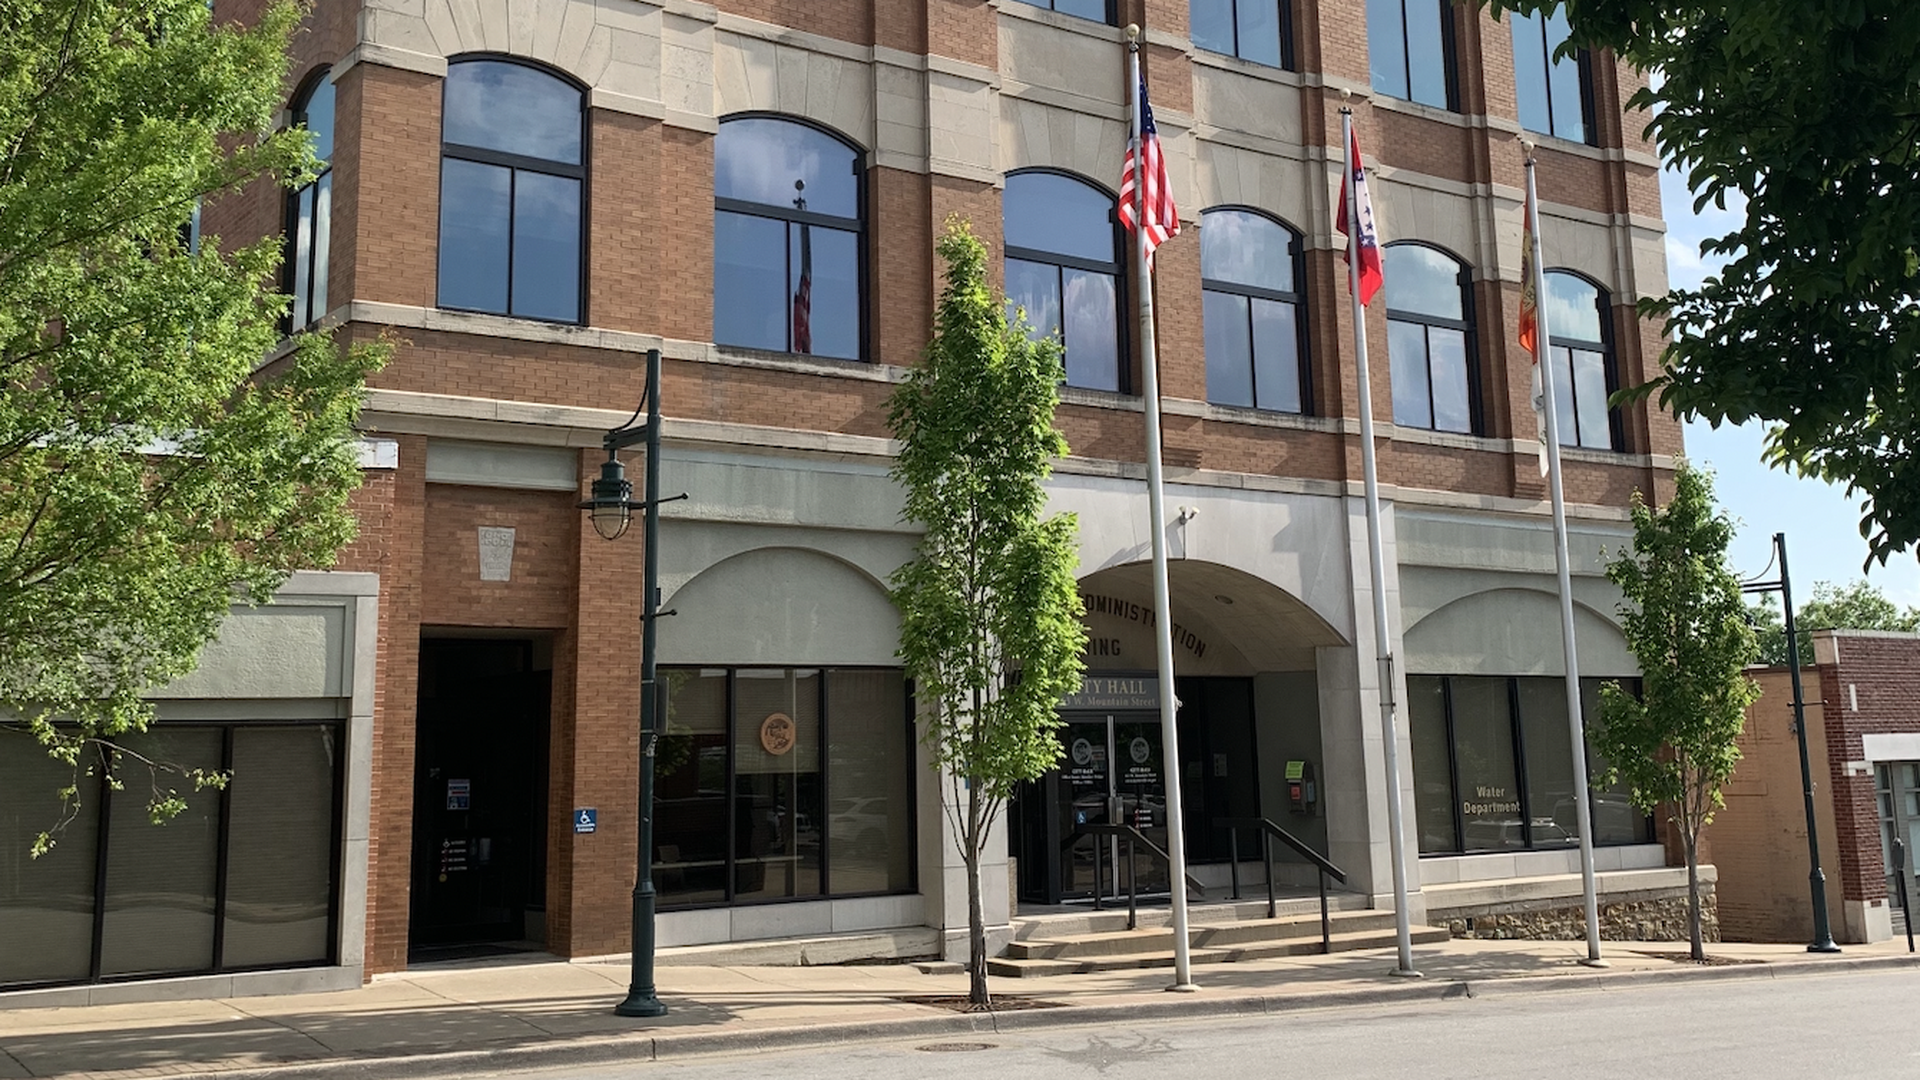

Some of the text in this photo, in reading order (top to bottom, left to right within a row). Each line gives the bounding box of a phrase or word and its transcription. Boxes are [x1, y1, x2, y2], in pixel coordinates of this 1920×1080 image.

[1084, 594, 1207, 658] DMINISTTION
[1082, 679, 1147, 694] TY HALL
[1073, 697, 1085, 706] W.
[1088, 696, 1128, 706] Mountain
[1131, 696, 1156, 706] Street
[1476, 786, 1505, 798] Water
[1463, 801, 1520, 816] Department
